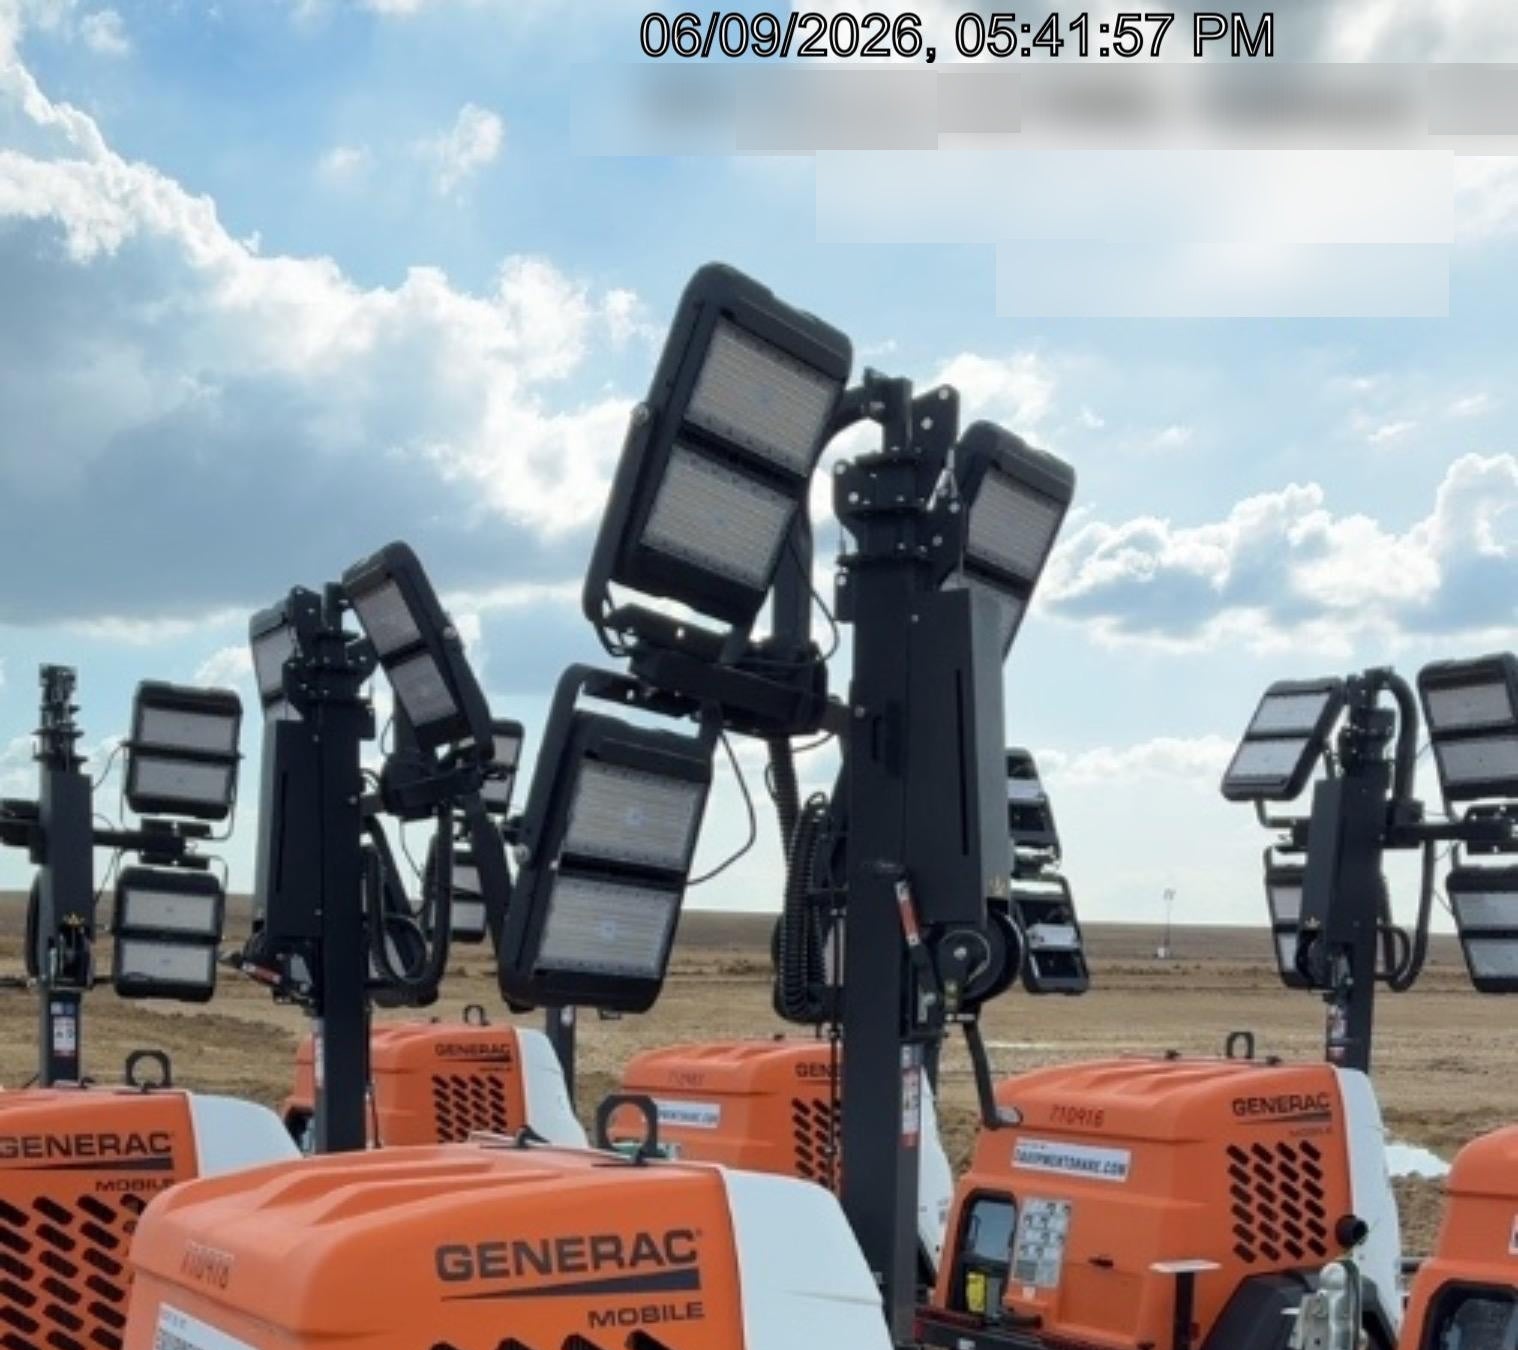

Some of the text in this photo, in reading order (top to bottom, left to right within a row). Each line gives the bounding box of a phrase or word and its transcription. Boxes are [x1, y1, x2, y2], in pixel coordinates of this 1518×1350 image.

[434, 1043, 511, 1056] GENERAC
[1232, 1092, 1329, 1117] GENERAC
[0, 1132, 171, 1158] GENERAC
[435, 1229, 699, 1282] GENERAC
[588, 1301, 704, 1329] MOBILE
